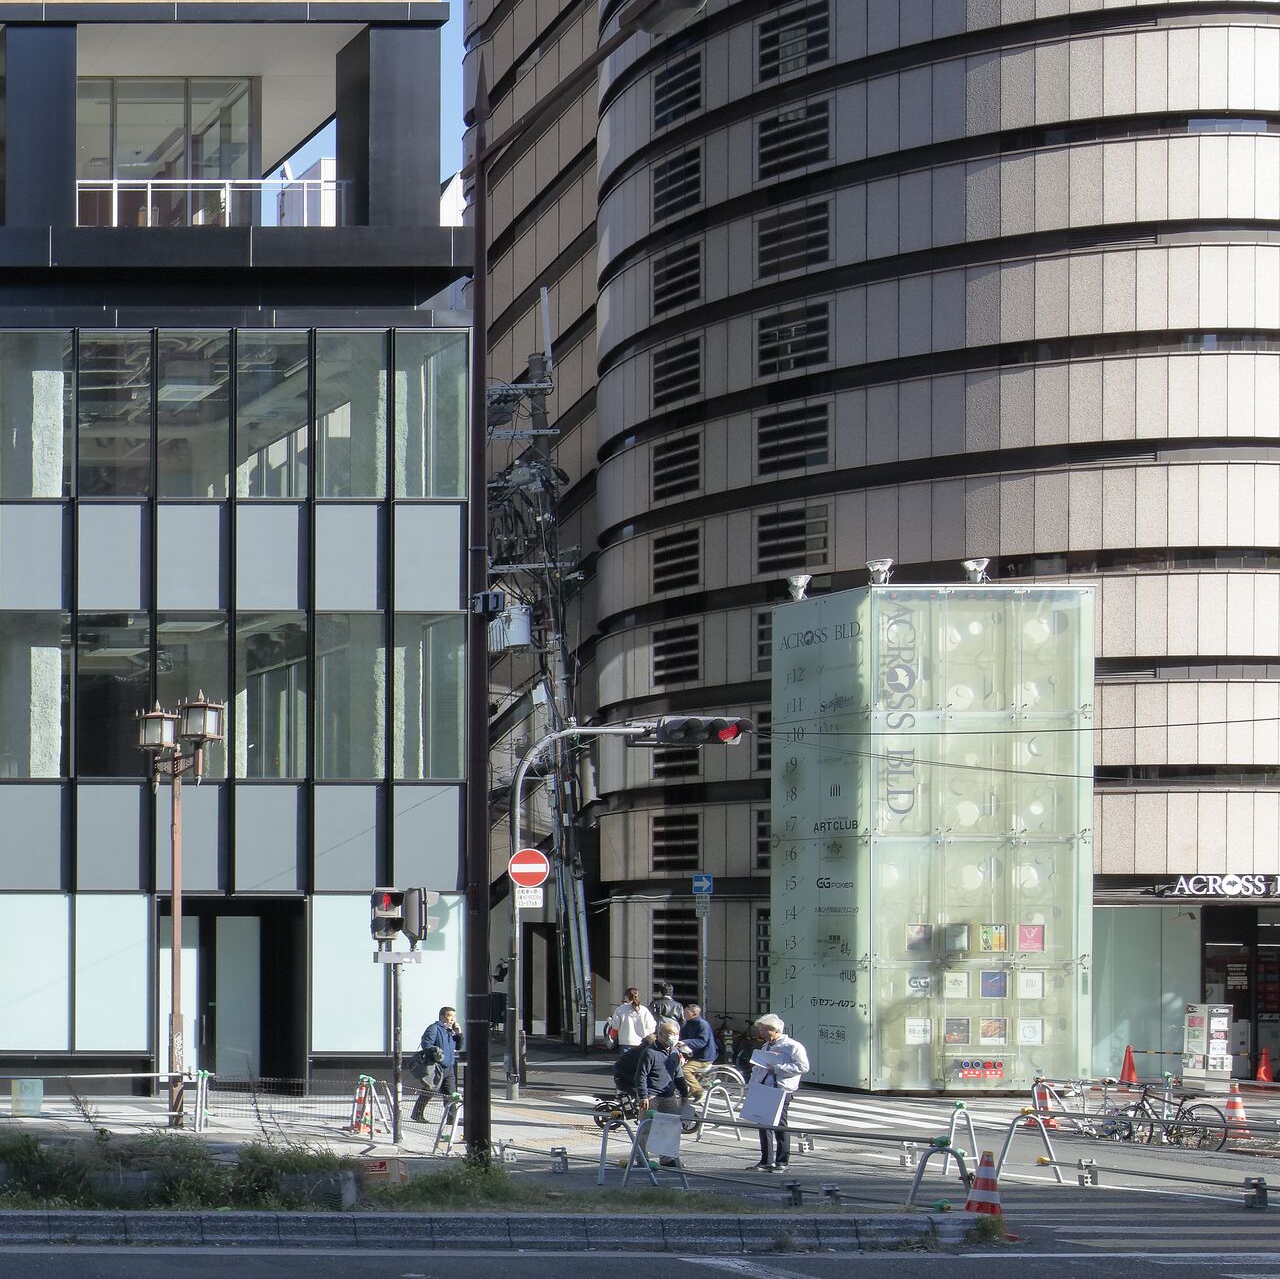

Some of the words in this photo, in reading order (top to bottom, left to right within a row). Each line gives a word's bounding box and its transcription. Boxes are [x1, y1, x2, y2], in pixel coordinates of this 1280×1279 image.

[780, 627, 828, 650] ACROSS
[835, 621, 860, 640] BLD
[886, 601, 916, 730] ACROSS
[886, 748, 915, 814] BLD
[1172, 874, 1266, 895] ACROSS
